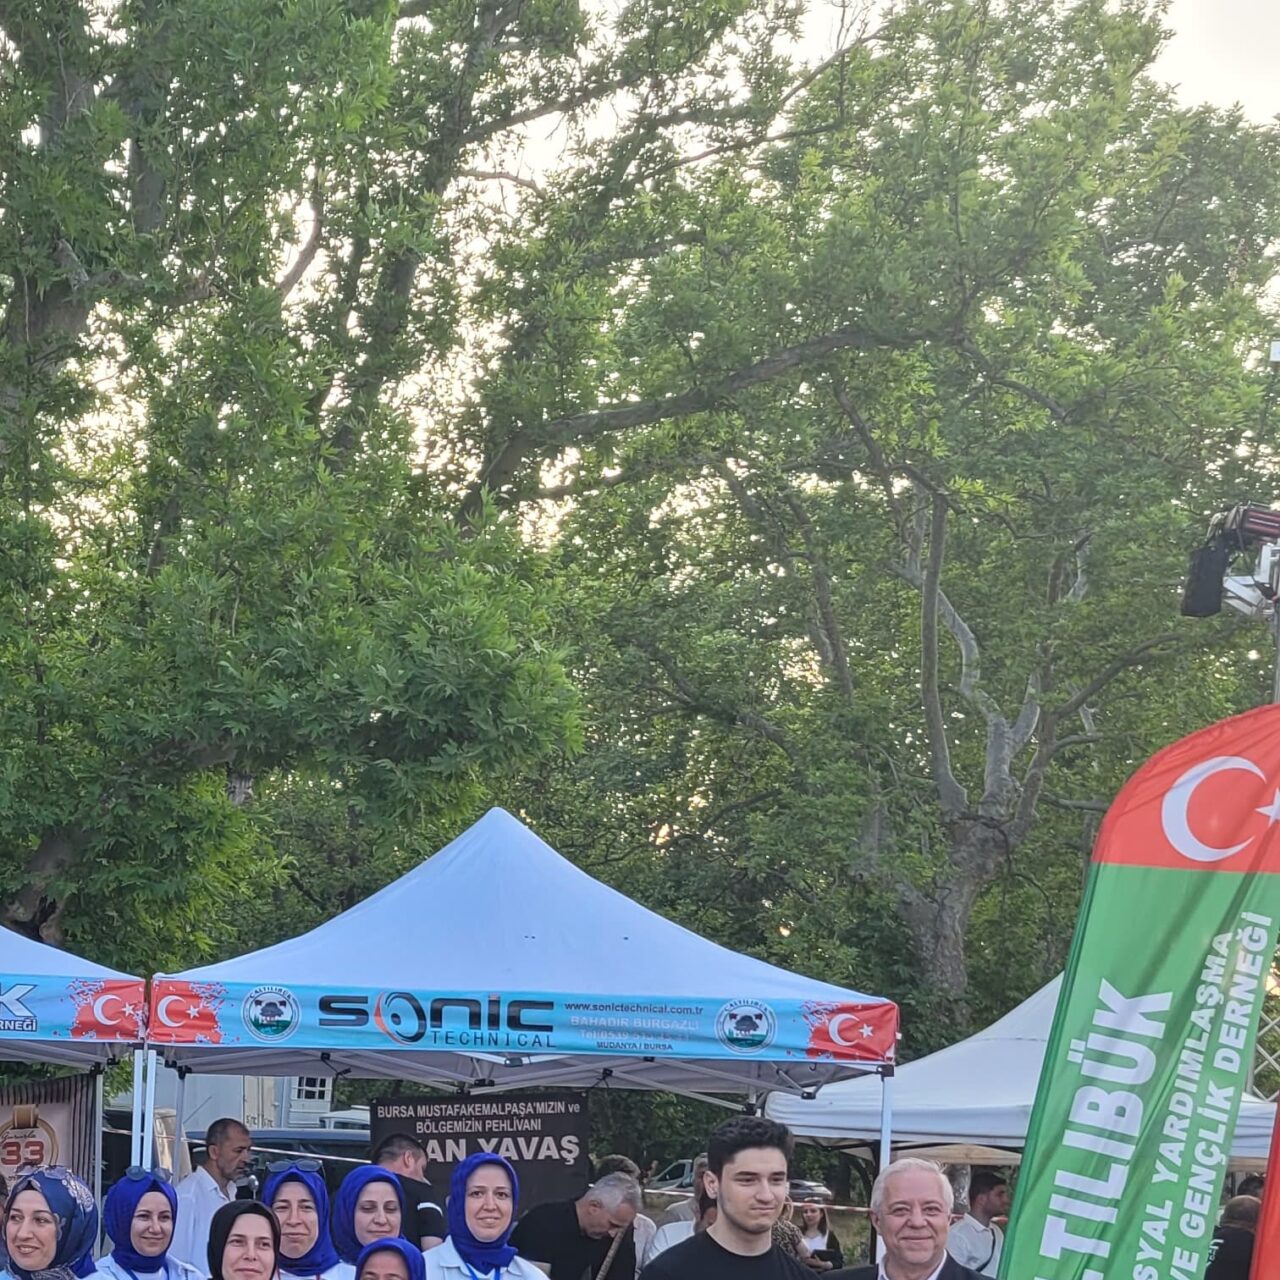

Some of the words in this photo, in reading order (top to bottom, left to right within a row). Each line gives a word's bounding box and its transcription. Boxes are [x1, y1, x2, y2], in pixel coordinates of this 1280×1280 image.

[564, 1001, 704, 1016] www.sonictechnical.com.tr
[431, 1030, 558, 1048] TECHNICAL
[643, 1042, 673, 1051] BURSA
[1151, 932, 1233, 1184] YARDIMLAŞMA
[1179, 1079, 1236, 1238] GENÇLİK
[1213, 911, 1273, 1074] DERNEĞİ
[377, 1105, 415, 1118] BURSA
[417, 1101, 565, 1118] MUSTAFAKEMALPAŞA'MIZIN
[416, 1117, 482, 1134] BÖLGEMİZİN
[485, 1116, 541, 1132] PEHLİVANI
[0, 1141, 45, 1165] 33
[477, 1135, 580, 1165] YAVAŞ
